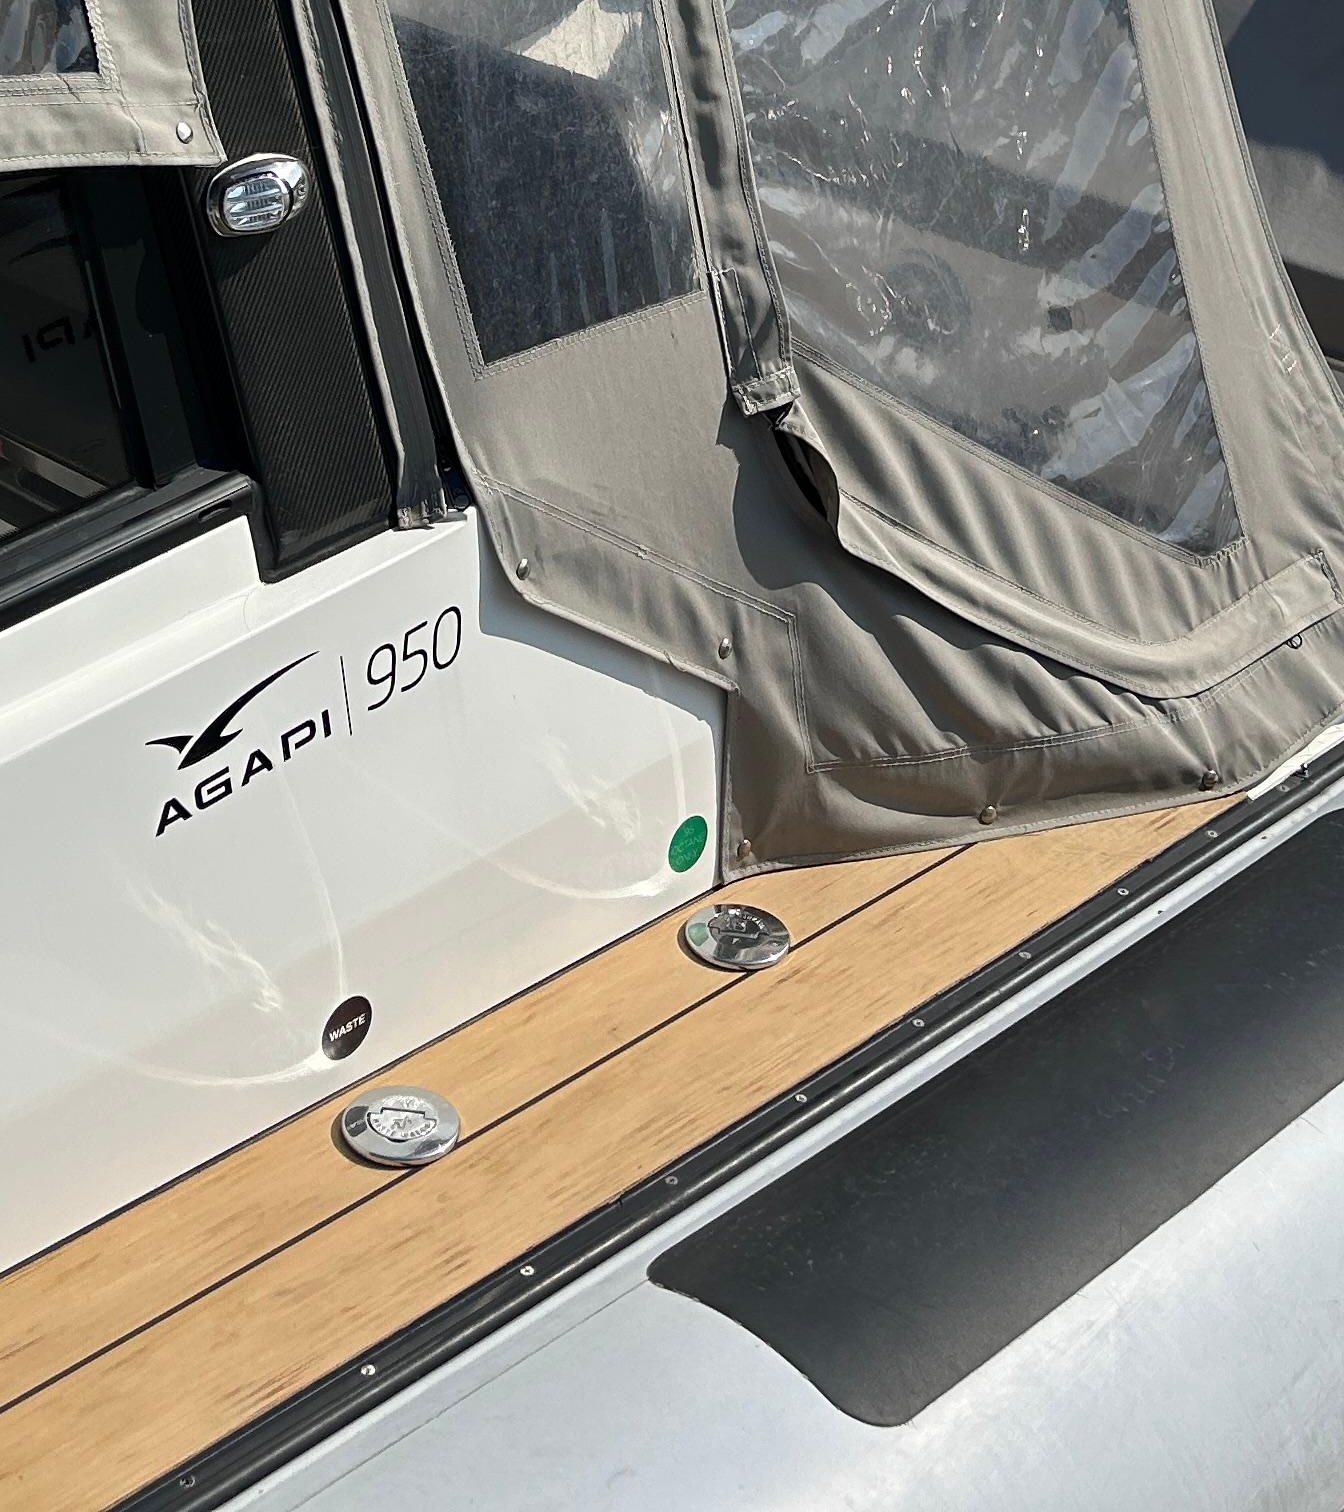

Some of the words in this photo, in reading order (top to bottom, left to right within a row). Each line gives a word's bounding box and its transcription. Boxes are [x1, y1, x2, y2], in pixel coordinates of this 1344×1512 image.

[155, 708, 333, 838] AGAPI
[366, 605, 462, 711] 950
[328, 1012, 367, 1042] WASTE
